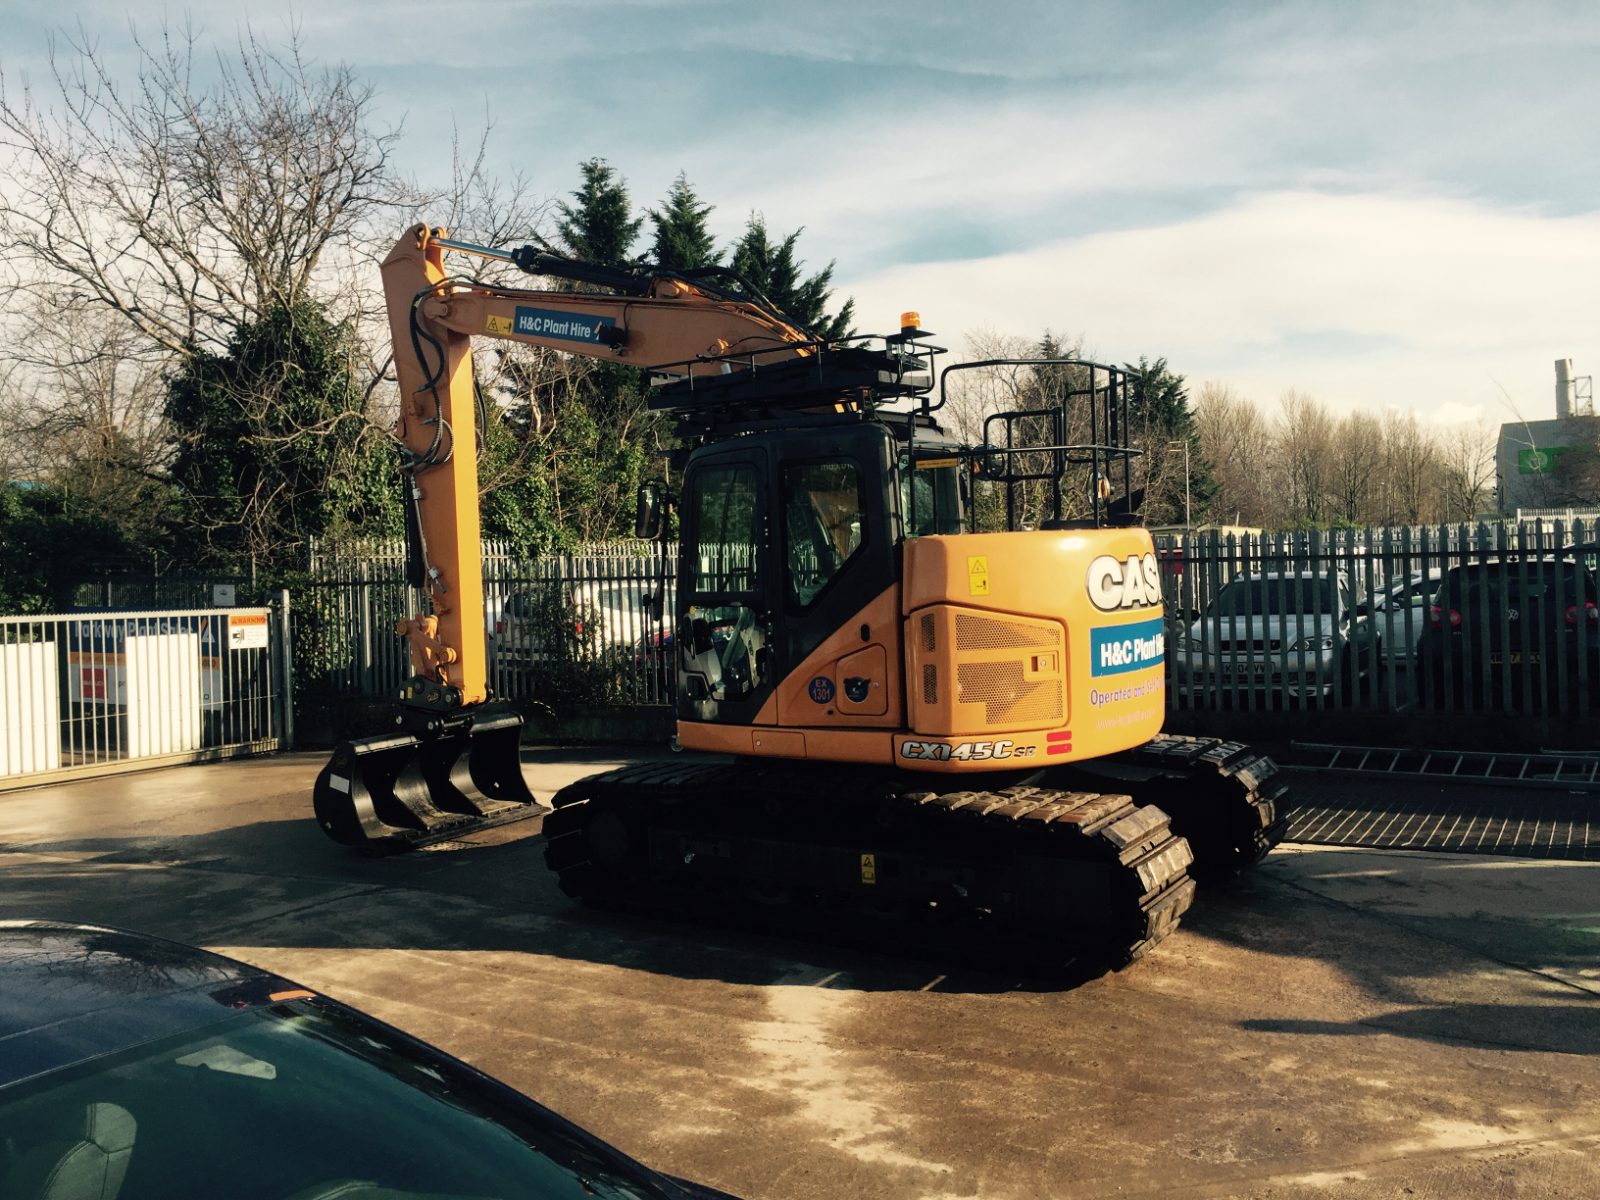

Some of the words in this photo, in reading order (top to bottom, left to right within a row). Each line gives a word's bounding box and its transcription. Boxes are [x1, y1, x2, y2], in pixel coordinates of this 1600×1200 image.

[519, 315, 542, 331] H&C
[543, 318, 569, 335] Plant
[569, 321, 591, 338] Hire
[1087, 552, 1163, 610] CAS
[128, 621, 159, 637] Pant
[1100, 639, 1132, 667] H&C
[1133, 635, 1156, 662] Plant
[1155, 632, 1164, 656] Hi
[815, 679, 828, 687] EX
[1090, 686, 1131, 709] Operated
[901, 740, 1013, 760] CX145C
